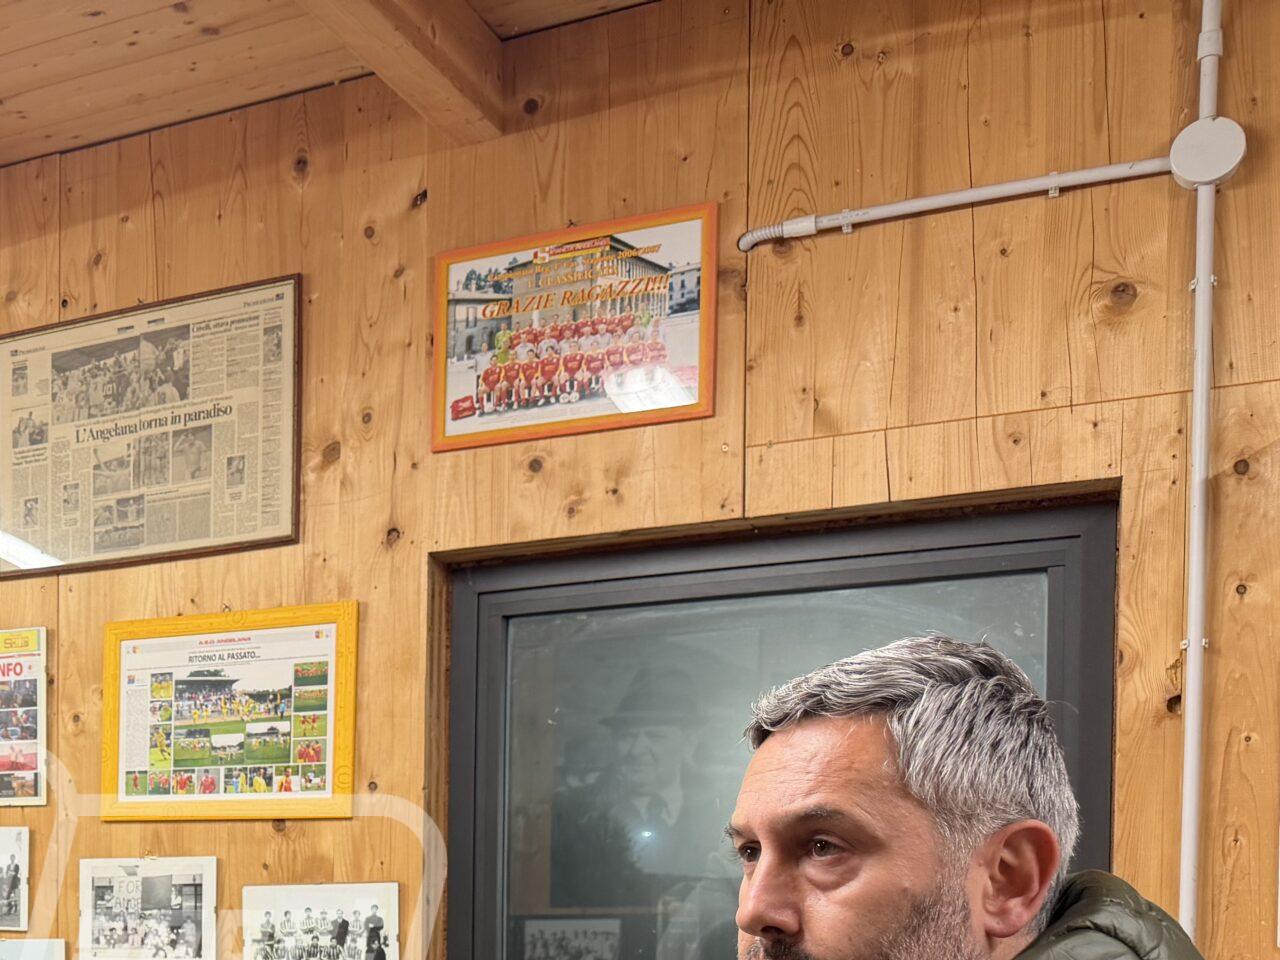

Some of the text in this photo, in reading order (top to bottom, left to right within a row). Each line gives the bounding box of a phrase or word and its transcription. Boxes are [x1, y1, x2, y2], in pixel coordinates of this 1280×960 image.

[482, 292, 556, 319] GRAZIE
[75, 402, 233, 443] L'Angelana torna in paradiso
[187, 653, 217, 664] RITORNO
[217, 653, 226, 662] AL
